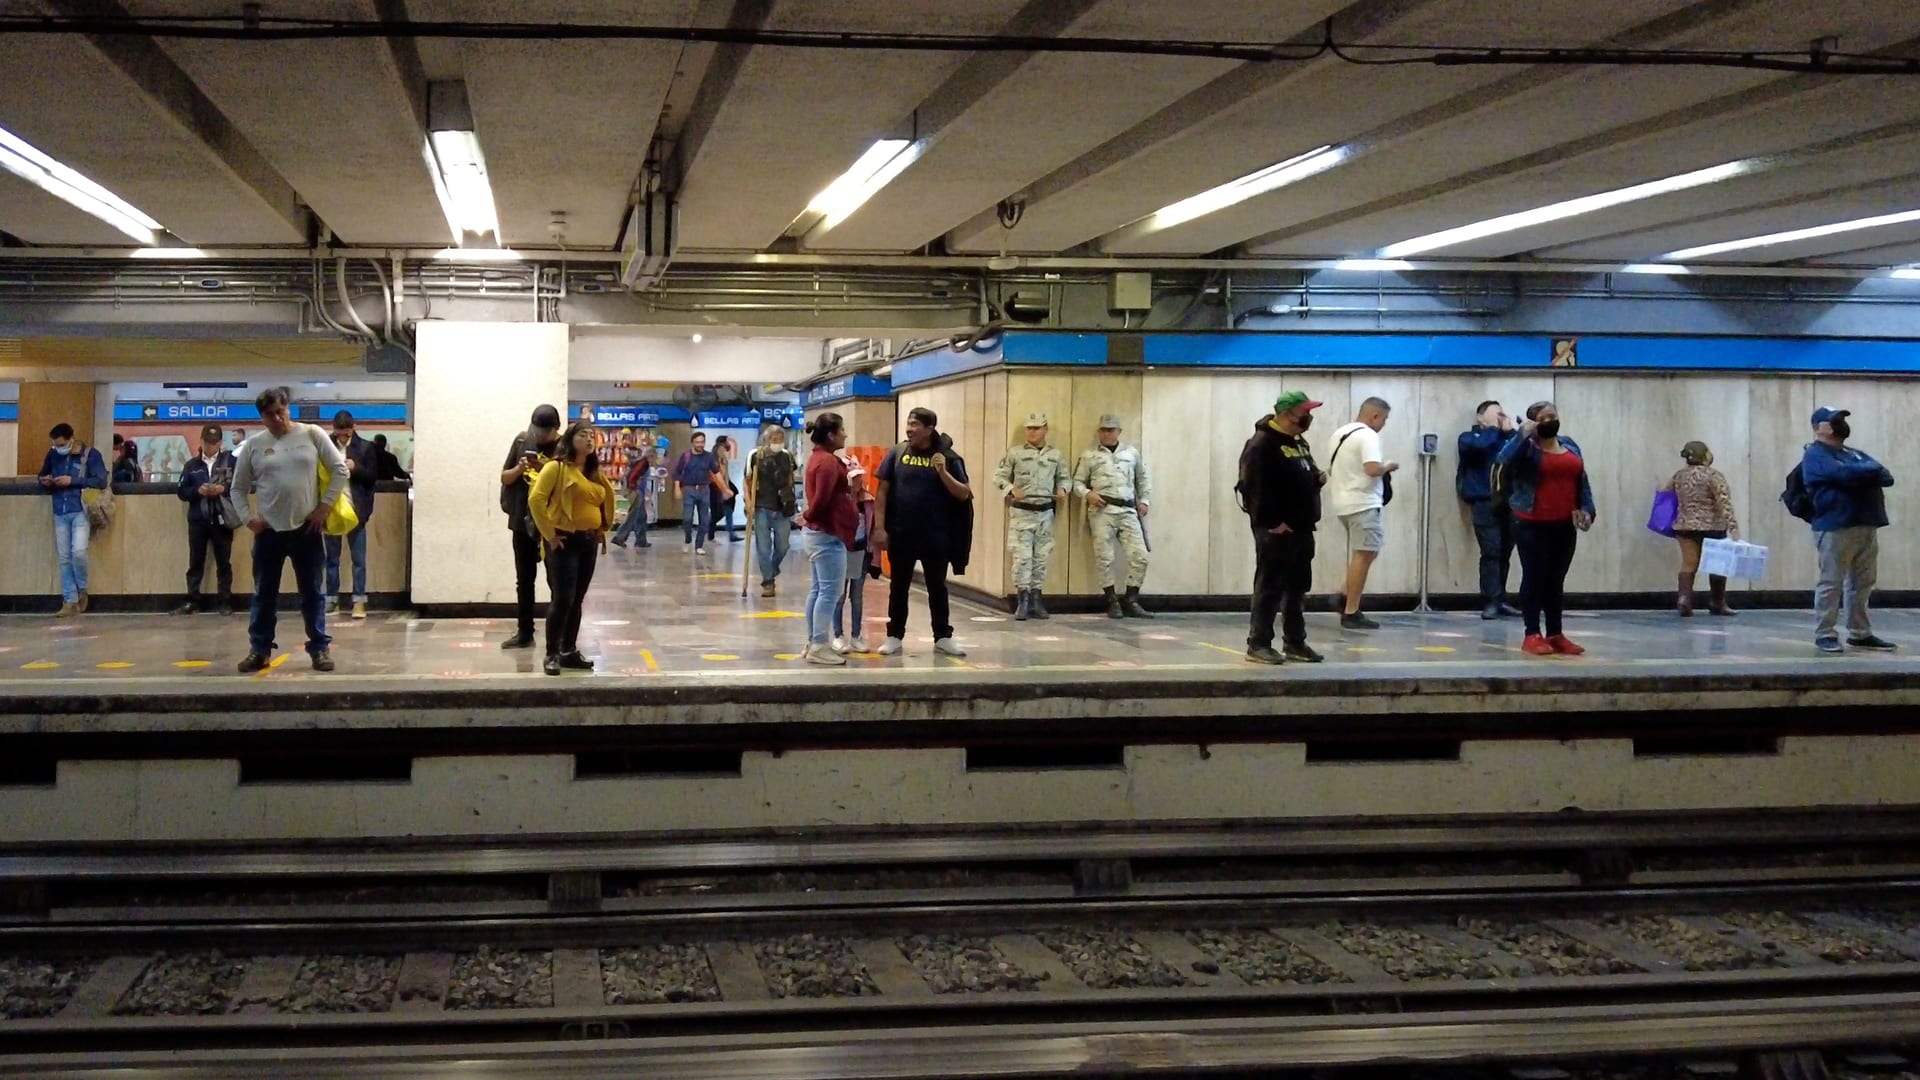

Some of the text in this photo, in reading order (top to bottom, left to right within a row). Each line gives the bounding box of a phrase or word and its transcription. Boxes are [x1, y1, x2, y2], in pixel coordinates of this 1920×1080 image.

[168, 405, 228, 417] SALIDA
[597, 412, 635, 421] BELLAS
[703, 417, 739, 425] BELLAS
